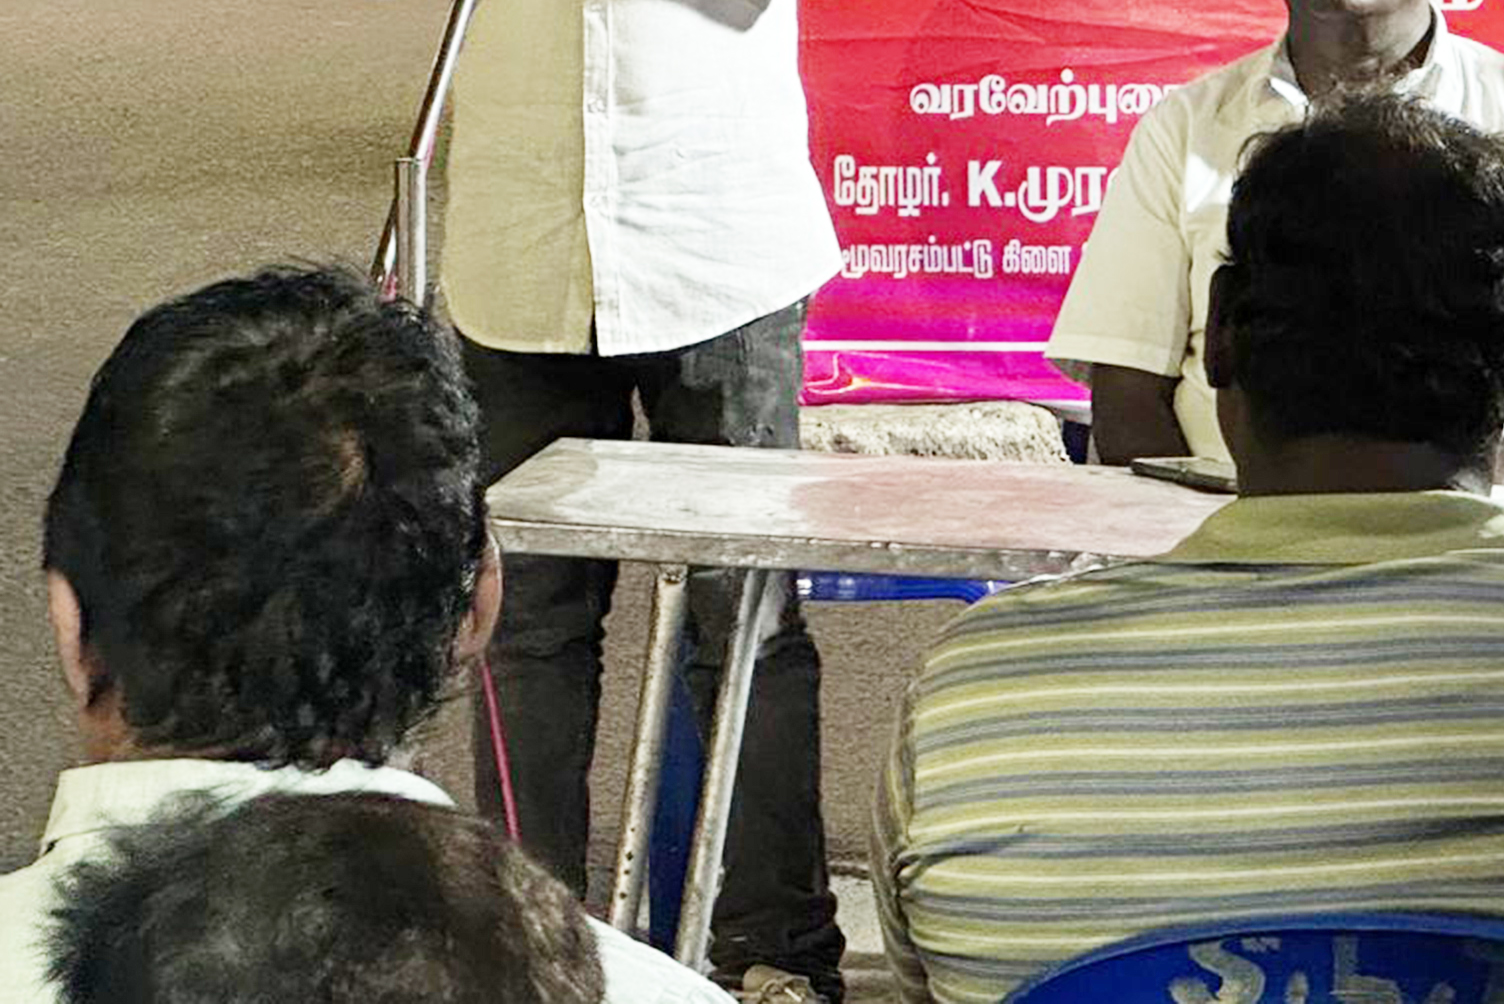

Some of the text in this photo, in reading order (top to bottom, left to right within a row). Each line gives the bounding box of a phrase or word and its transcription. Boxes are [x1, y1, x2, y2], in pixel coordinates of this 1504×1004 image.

[834, 152, 1120, 226] தோழர். K.முர
[1003, 239, 1072, 274] கிளை
